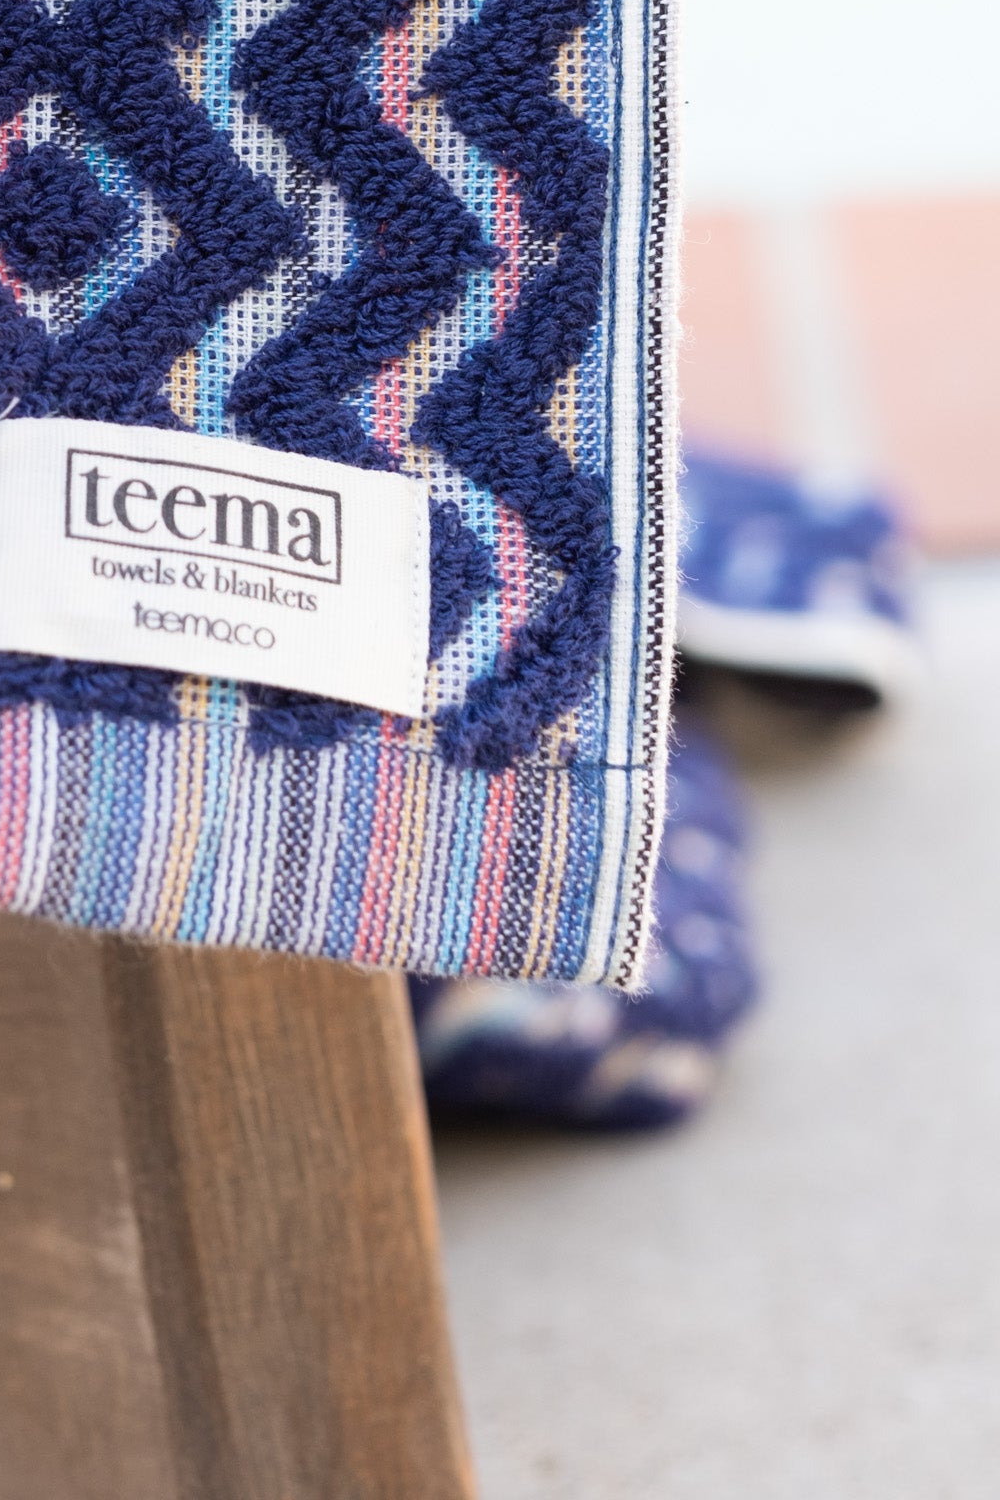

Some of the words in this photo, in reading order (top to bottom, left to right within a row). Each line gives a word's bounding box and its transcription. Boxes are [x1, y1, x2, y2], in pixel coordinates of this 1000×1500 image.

[80, 466, 331, 566] teema
[92, 555, 176, 587] towels
[183, 561, 208, 590] &
[213, 568, 318, 612] blankets
[133, 601, 276, 650] teemaco
